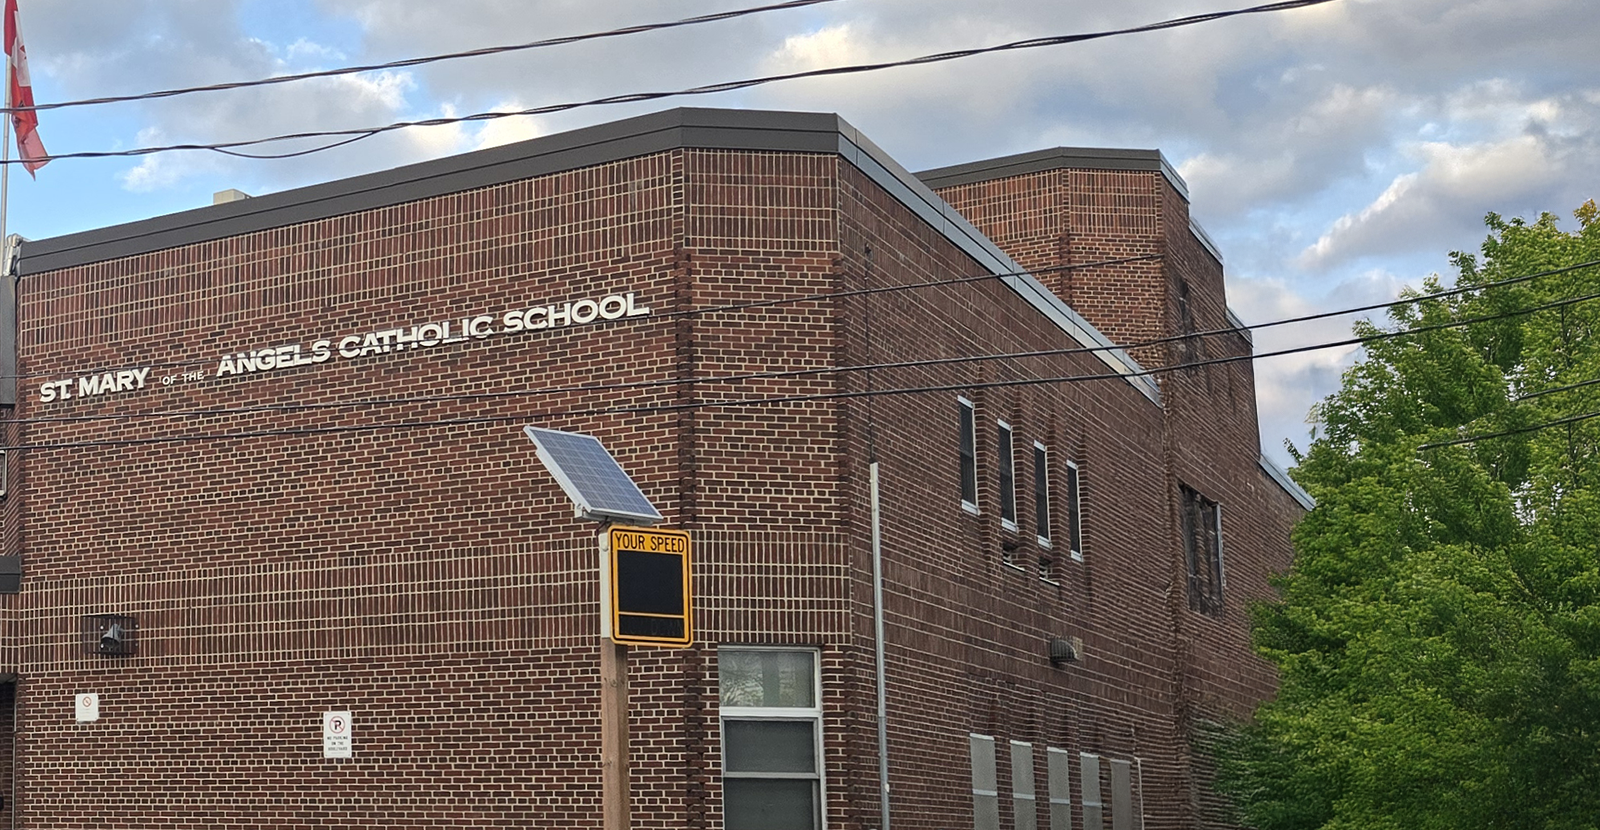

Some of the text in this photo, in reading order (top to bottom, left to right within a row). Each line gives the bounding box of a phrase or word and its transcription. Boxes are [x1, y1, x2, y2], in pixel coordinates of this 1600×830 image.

[39, 292, 650, 403] ST. MARY OF THE ANGELS CATHOLIC SCHOOL
[614, 533, 685, 553] YOUR SPEED
